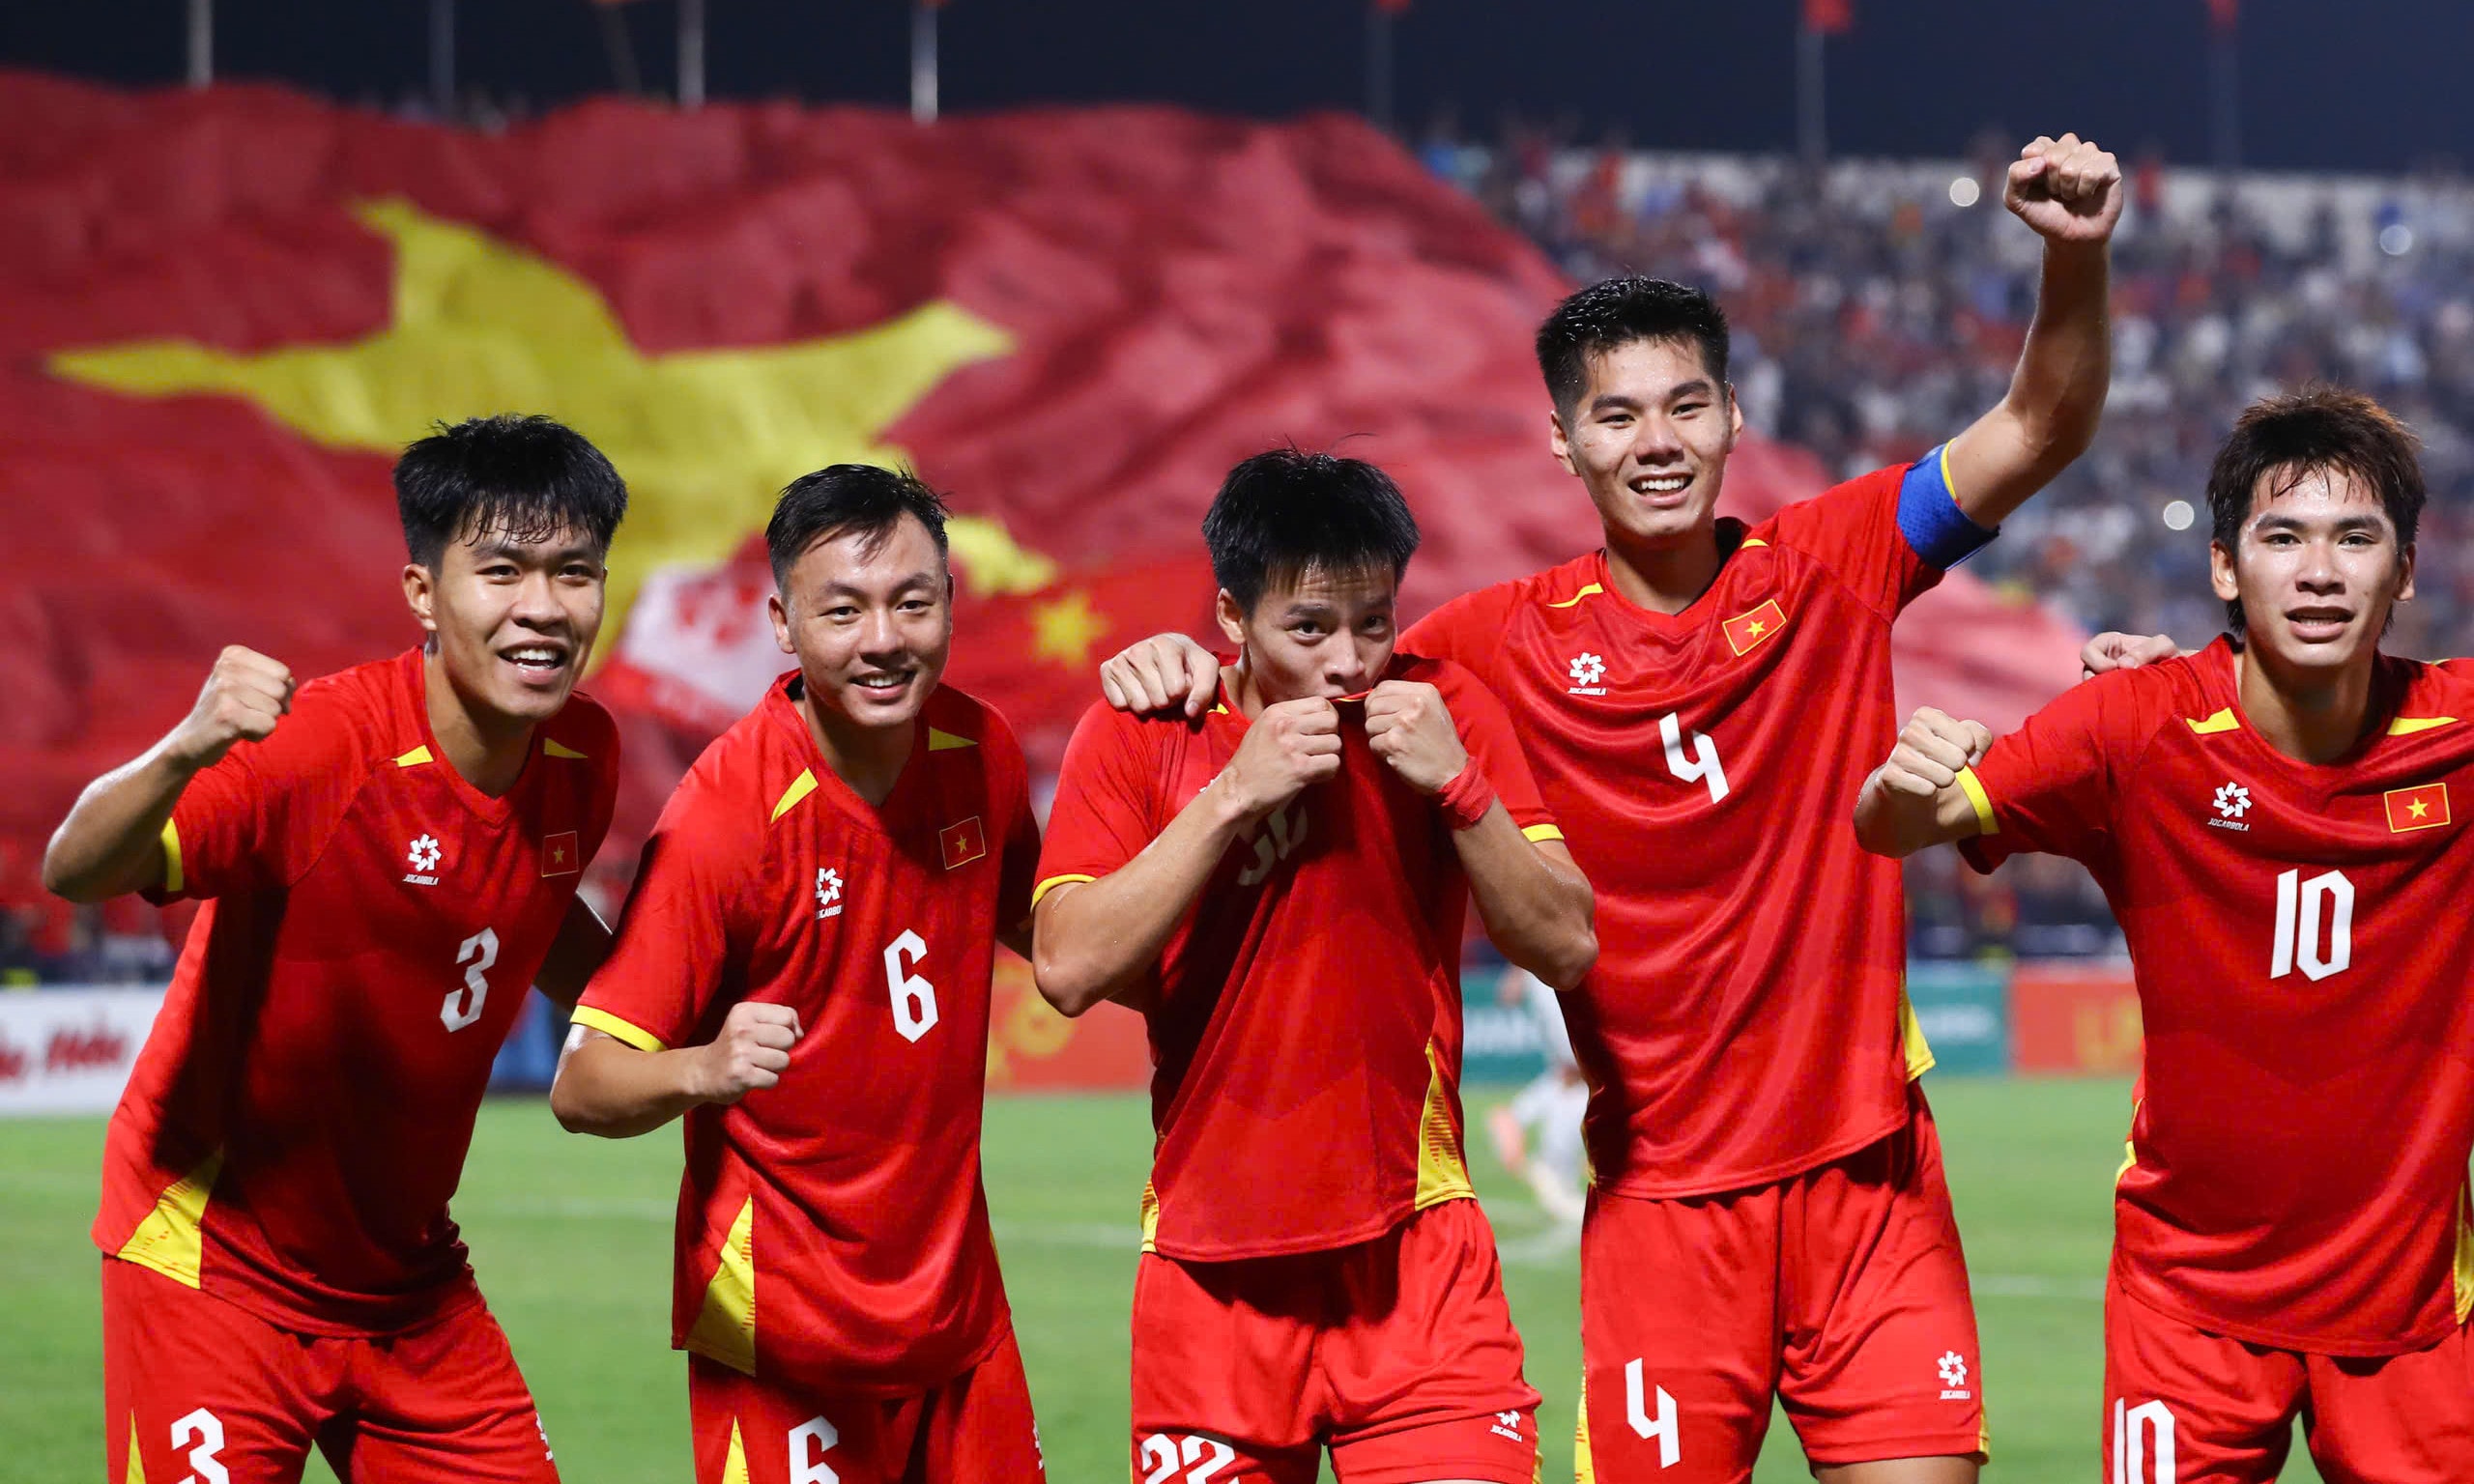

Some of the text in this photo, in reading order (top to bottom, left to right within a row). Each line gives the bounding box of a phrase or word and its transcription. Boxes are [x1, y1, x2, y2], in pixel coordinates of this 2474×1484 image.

[1658, 712, 1730, 804] 4
[2207, 817, 2250, 832] JOCARBOLA
[2271, 869, 2355, 982] 10
[441, 927, 500, 1033] 3
[883, 928, 938, 1043] 6
[170, 1407, 230, 1484] 3
[788, 1414, 839, 1484] 6
[1625, 1357, 1681, 1469] 4
[2113, 1397, 2176, 1484] 10
